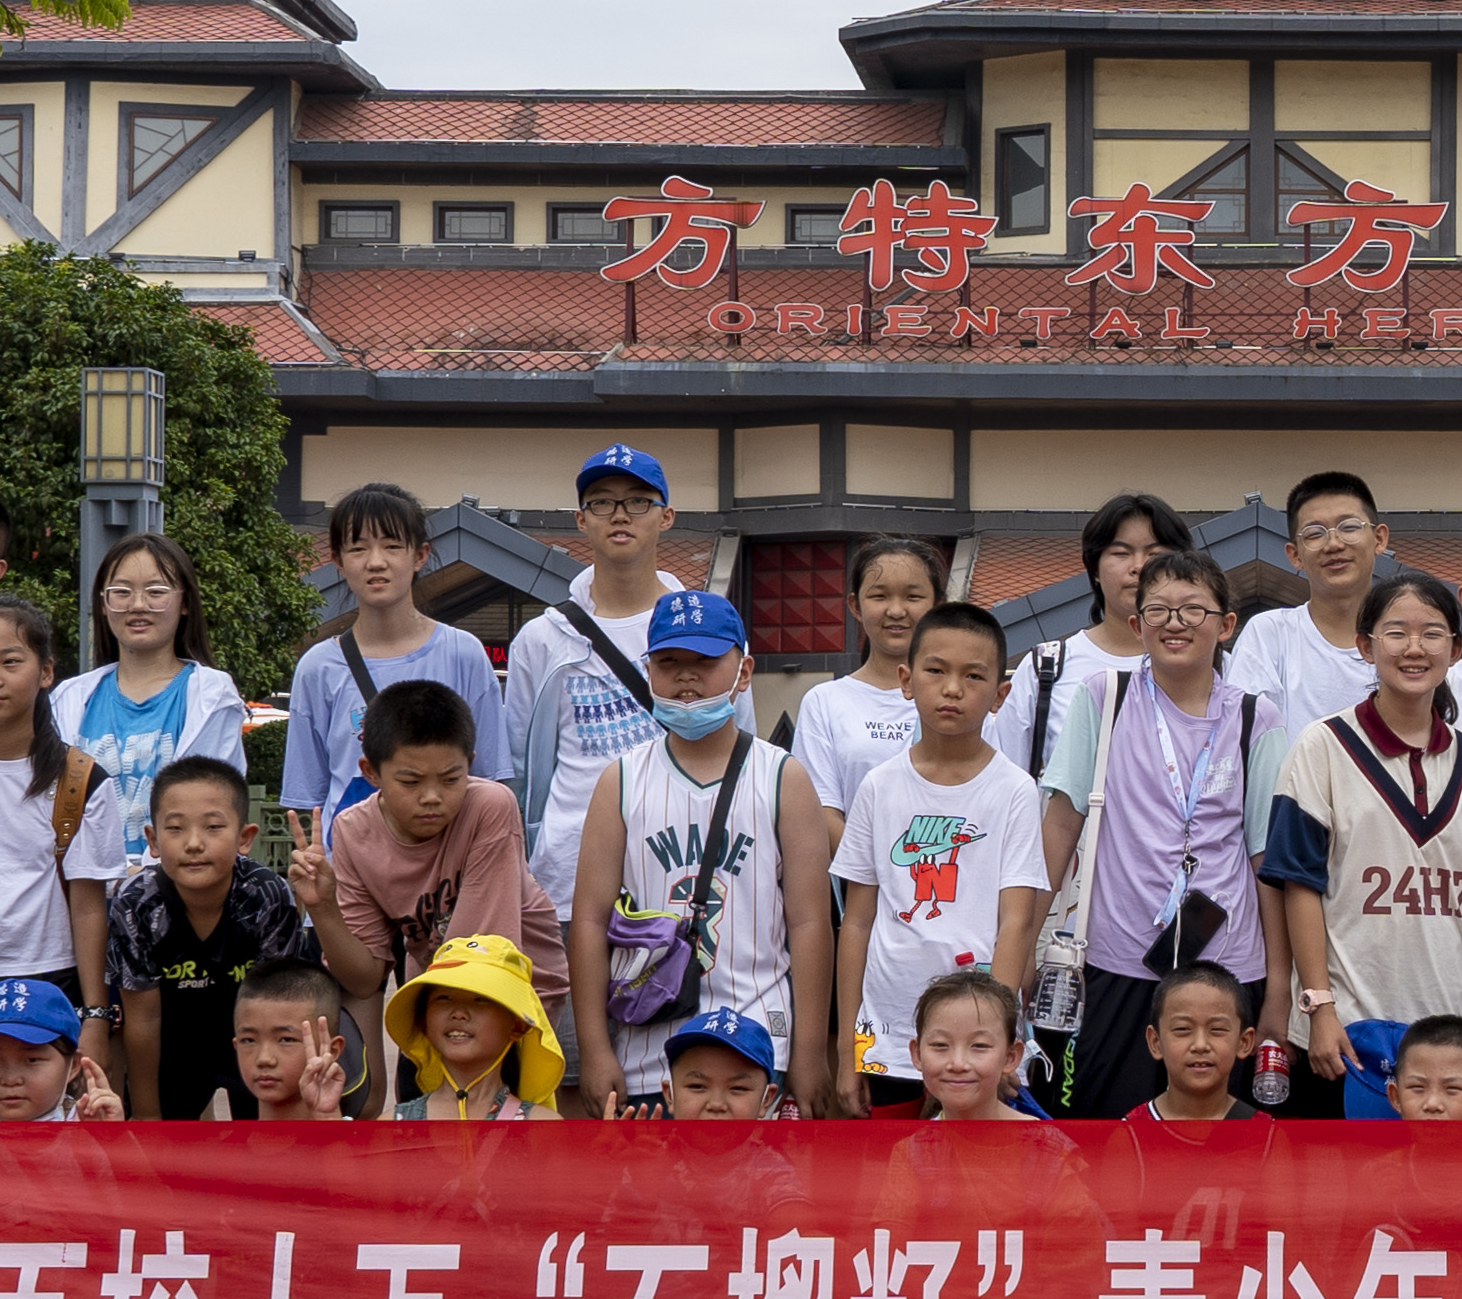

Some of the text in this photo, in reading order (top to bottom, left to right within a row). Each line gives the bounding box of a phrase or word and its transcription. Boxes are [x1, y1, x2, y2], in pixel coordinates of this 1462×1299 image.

[707, 302, 1211, 340] ORIENTAL
[869, 730, 906, 742] BEAR
[908, 815, 966, 845] NIKE
